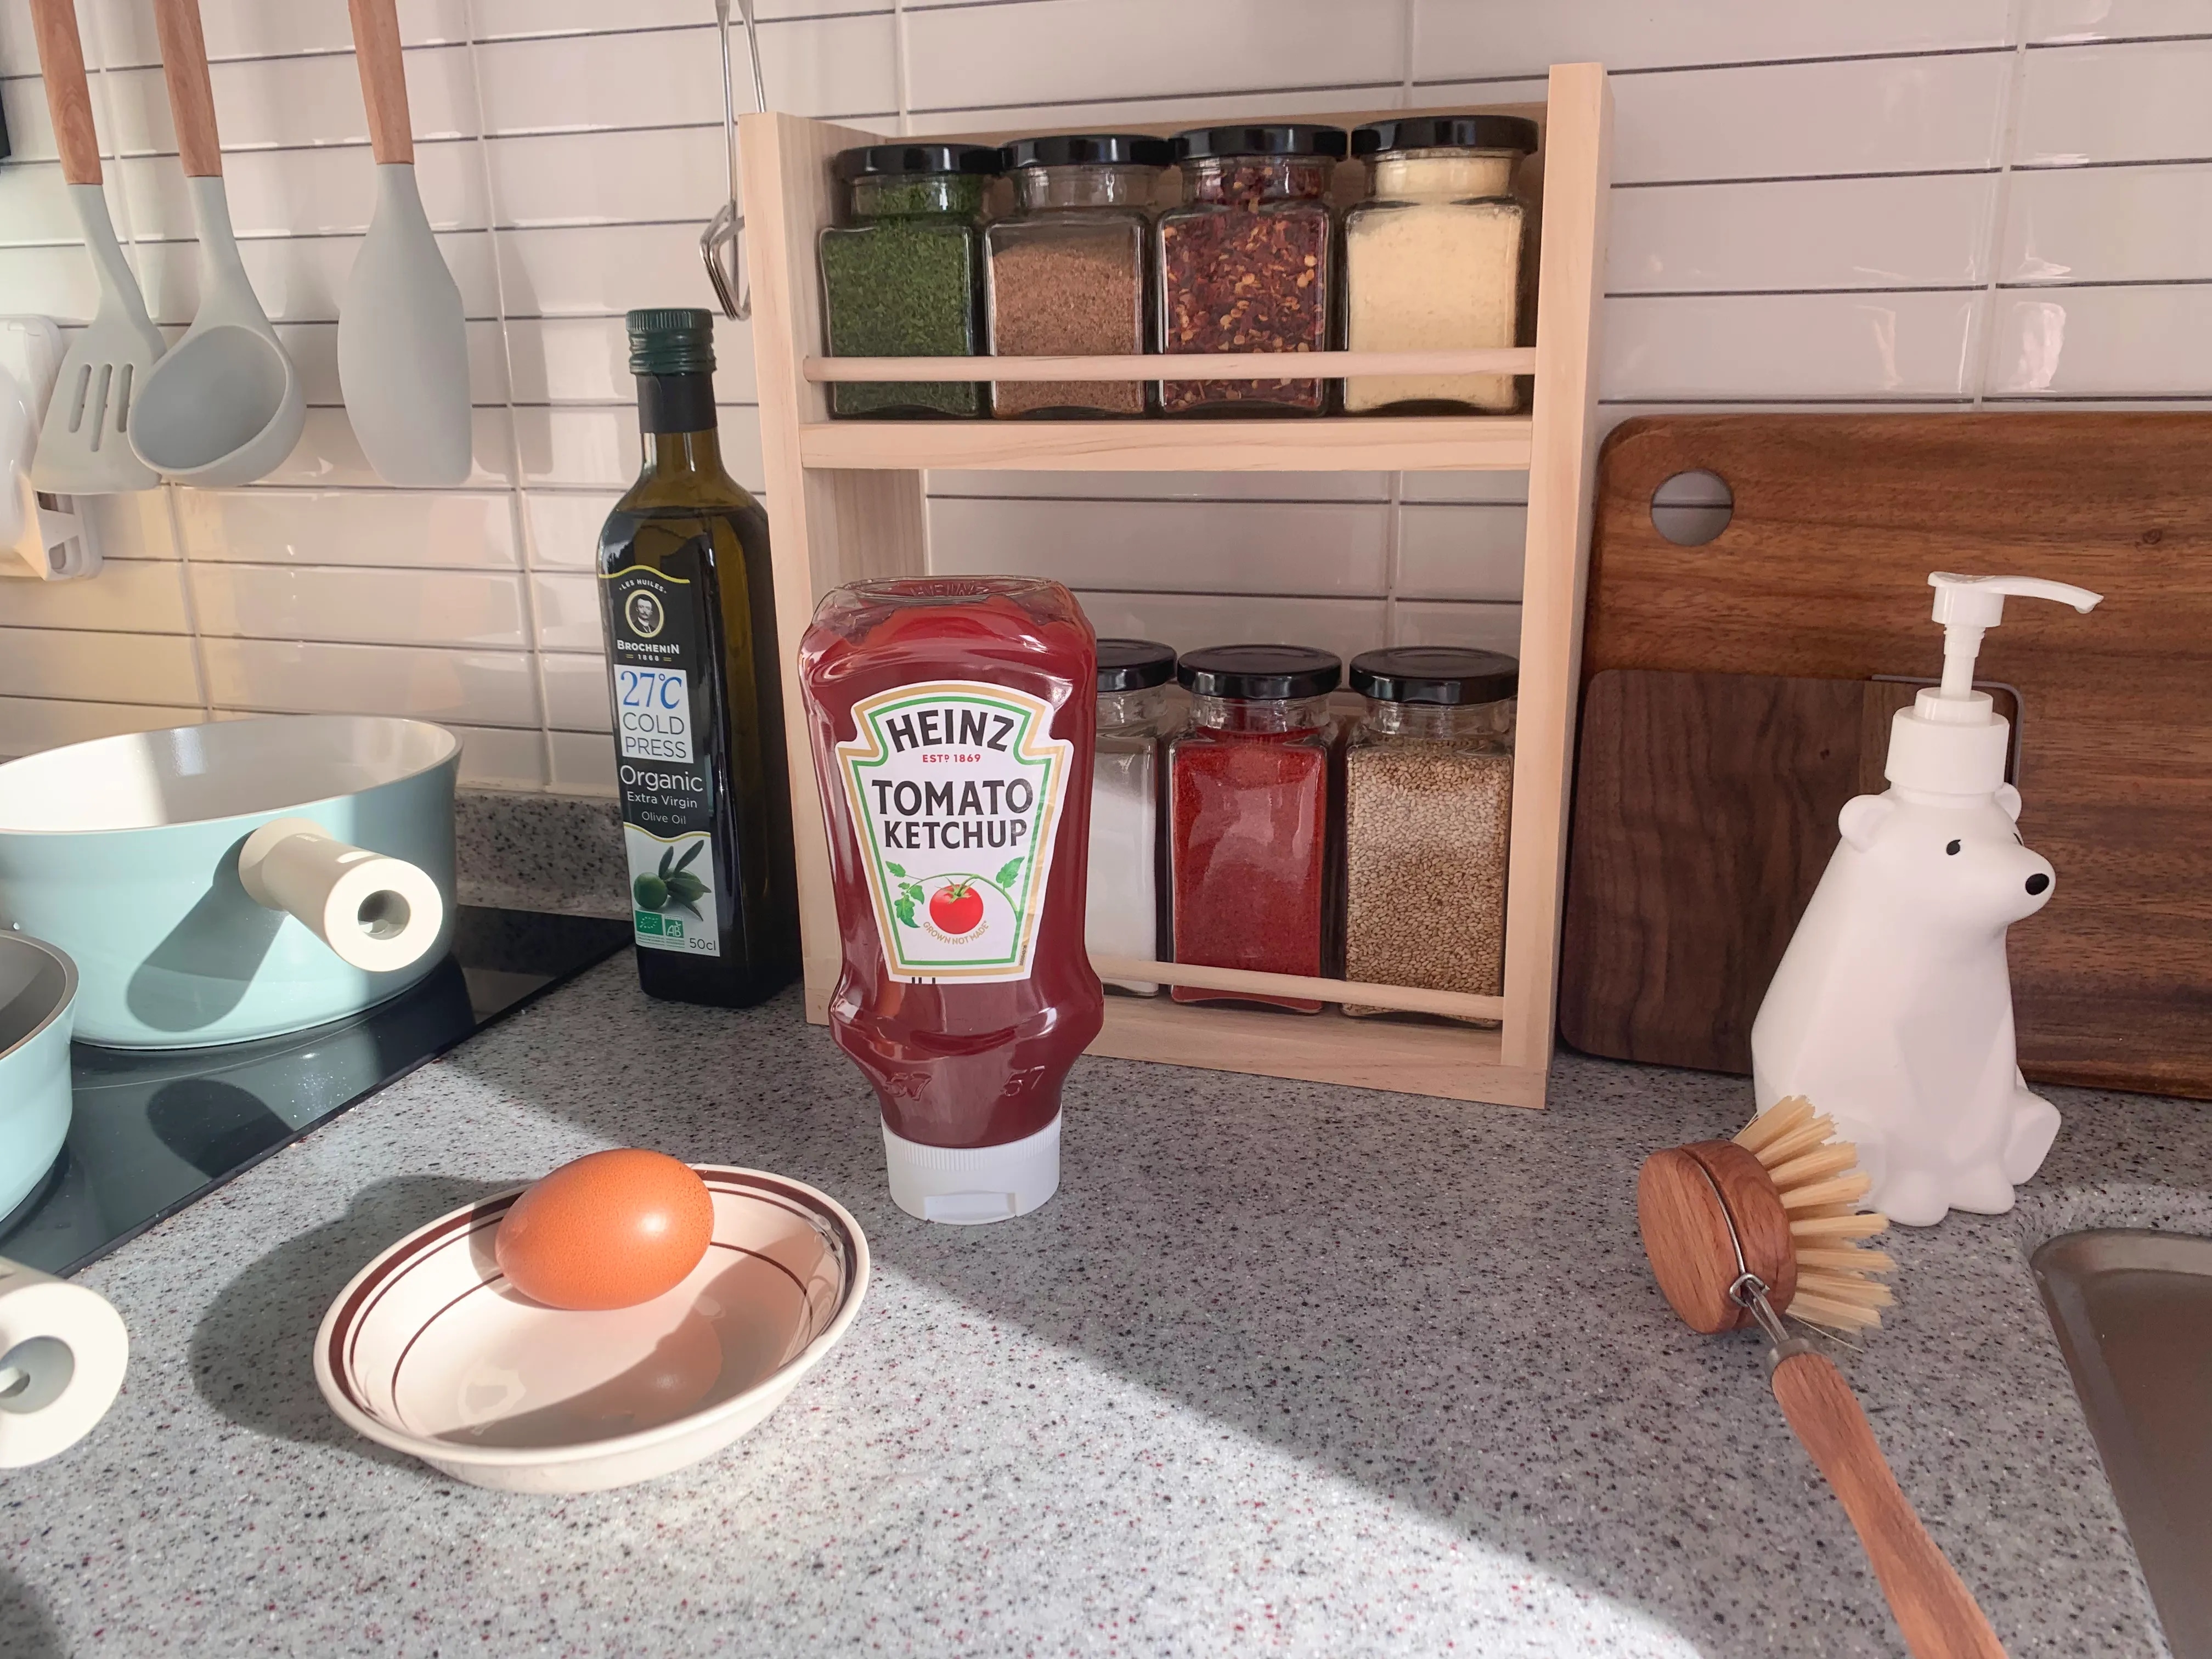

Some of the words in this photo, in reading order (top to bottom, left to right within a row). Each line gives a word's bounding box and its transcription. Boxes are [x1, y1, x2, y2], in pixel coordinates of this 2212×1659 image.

[622, 579, 635, 590] LES
[636, 579, 664, 592] HUILES
[617, 639, 680, 654] BROCHENIN
[620, 670, 682, 709] 27°C
[623, 712, 684, 735] COLD
[885, 709, 1014, 753] HEINZ
[625, 736, 686, 758] PRESS
[953, 754, 980, 763] 1869
[620, 765, 703, 792] Organic
[627, 791, 657, 804] Extra
[661, 795, 697, 809] Virgin
[872, 778, 1033, 816] TOMATO
[642, 811, 668, 822] Olive
[672, 815, 686, 824] Oil
[884, 819, 1027, 849] KETCHUP
[667, 925, 681, 937] AB
[923, 922, 951, 944] GROWN
[952, 936, 968, 945] NOT
[690, 938, 716, 951] 50cl
